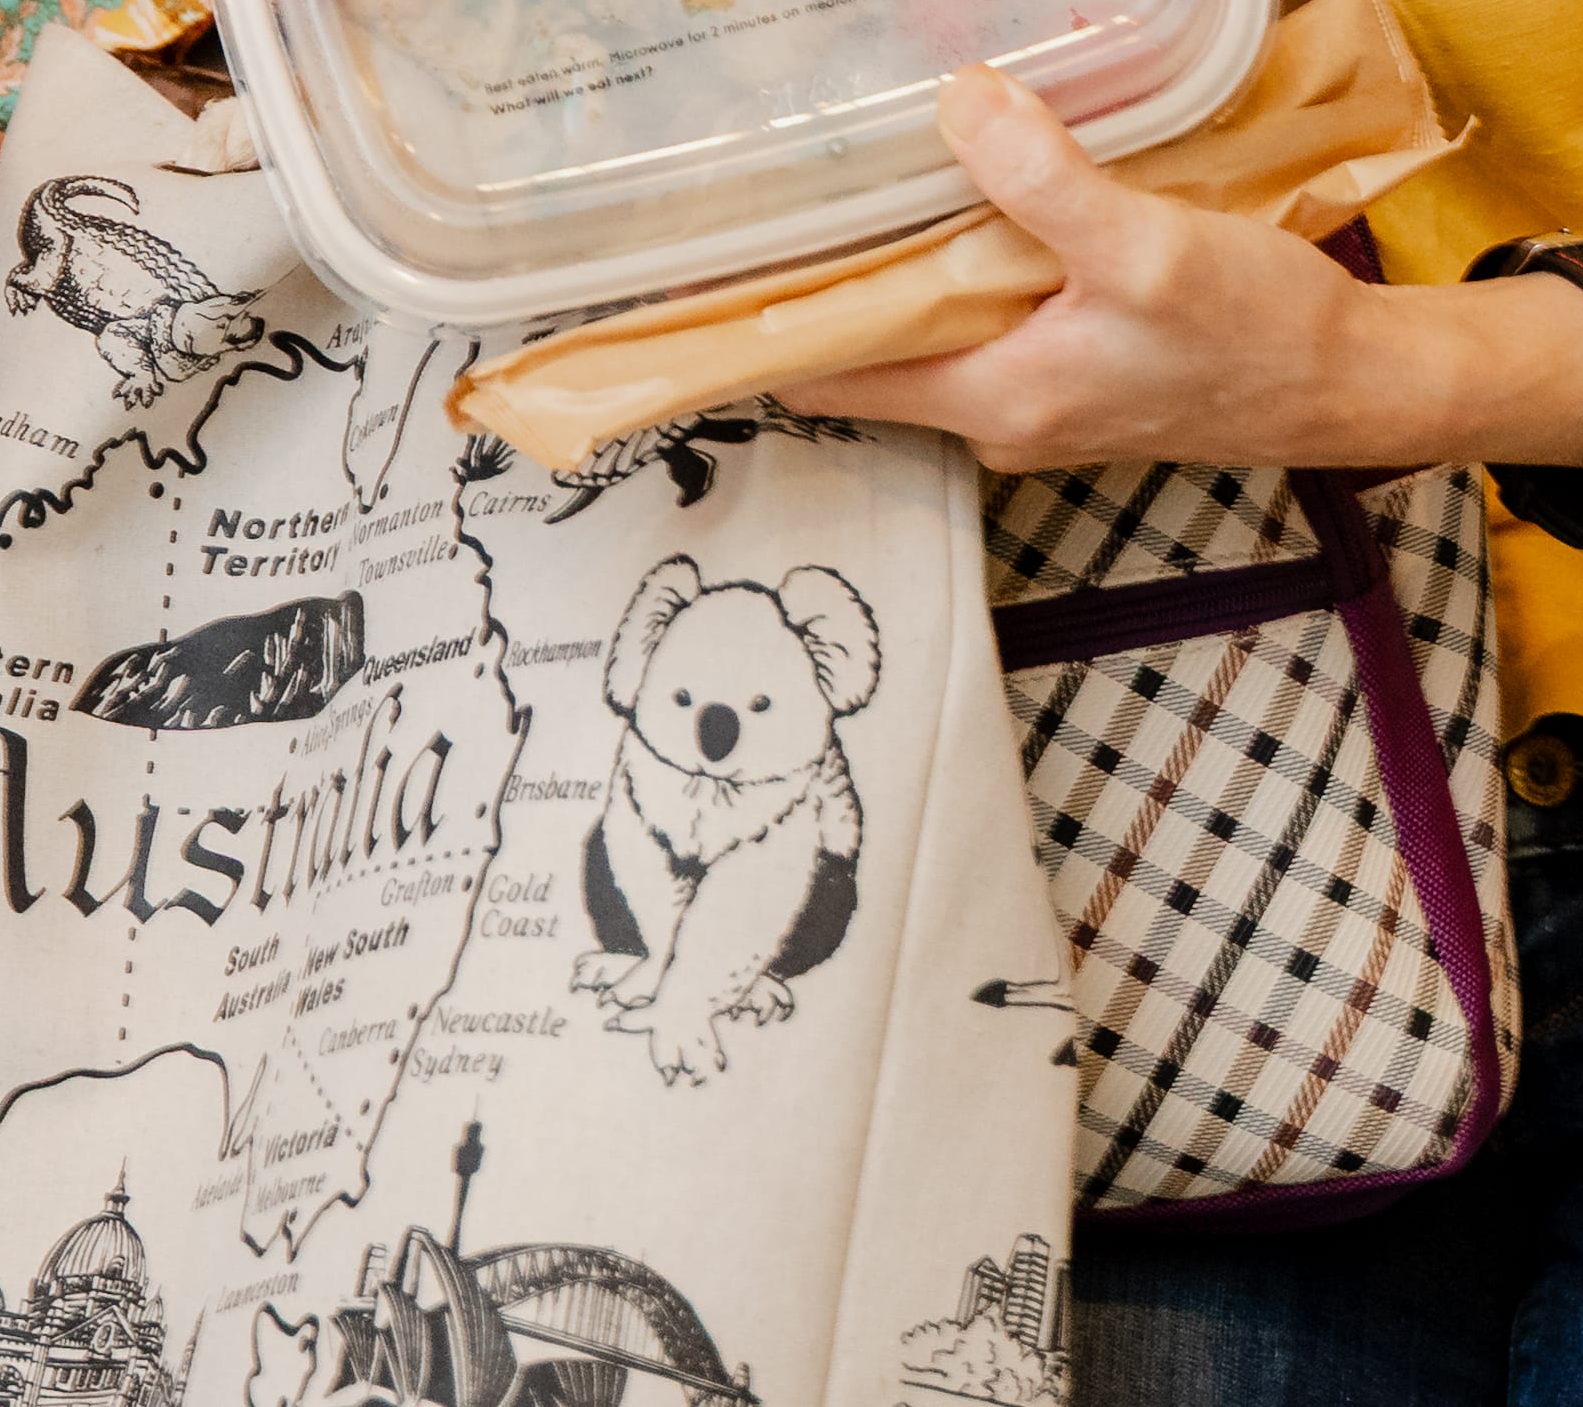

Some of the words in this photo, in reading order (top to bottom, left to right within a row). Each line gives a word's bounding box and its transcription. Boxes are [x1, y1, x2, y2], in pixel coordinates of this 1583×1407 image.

[484, 78, 514, 95] Best
[517, 67, 559, 87] eaten
[607, 36, 684, 64] Microwave
[687, 29, 708, 43] for
[710, 25, 720, 37] 2
[723, 12, 778, 35] minutes
[782, 7, 801, 20] on
[490, 94, 532, 116] What
[535, 88, 561, 107] will
[563, 84, 584, 99] we
[587, 75, 612, 92] eat
[615, 64, 655, 86] next?
[206, 501, 351, 542] Northern
[349, 497, 445, 553] Normanton
[467, 488, 555, 520] Cairns
[200, 538, 342, 578] Territory
[358, 533, 449, 589] Townsville
[361, 625, 478, 686] Queensland
[504, 769, 603, 804] Brisbane
[380, 869, 456, 908] Grafton
[487, 872, 554, 904] Gold
[480, 907, 561, 938] Coast
[224, 931, 282, 977] South
[301, 941, 341, 980] New
[341, 916, 411, 961] South
[212, 968, 292, 1024] Australia
[292, 977, 346, 1019] Wales
[318, 1016, 399, 1058] Canberra
[434, 1004, 569, 1038] Newcastle
[409, 1043, 506, 1083] Sydney
[263, 1119, 341, 1169] Victoria
